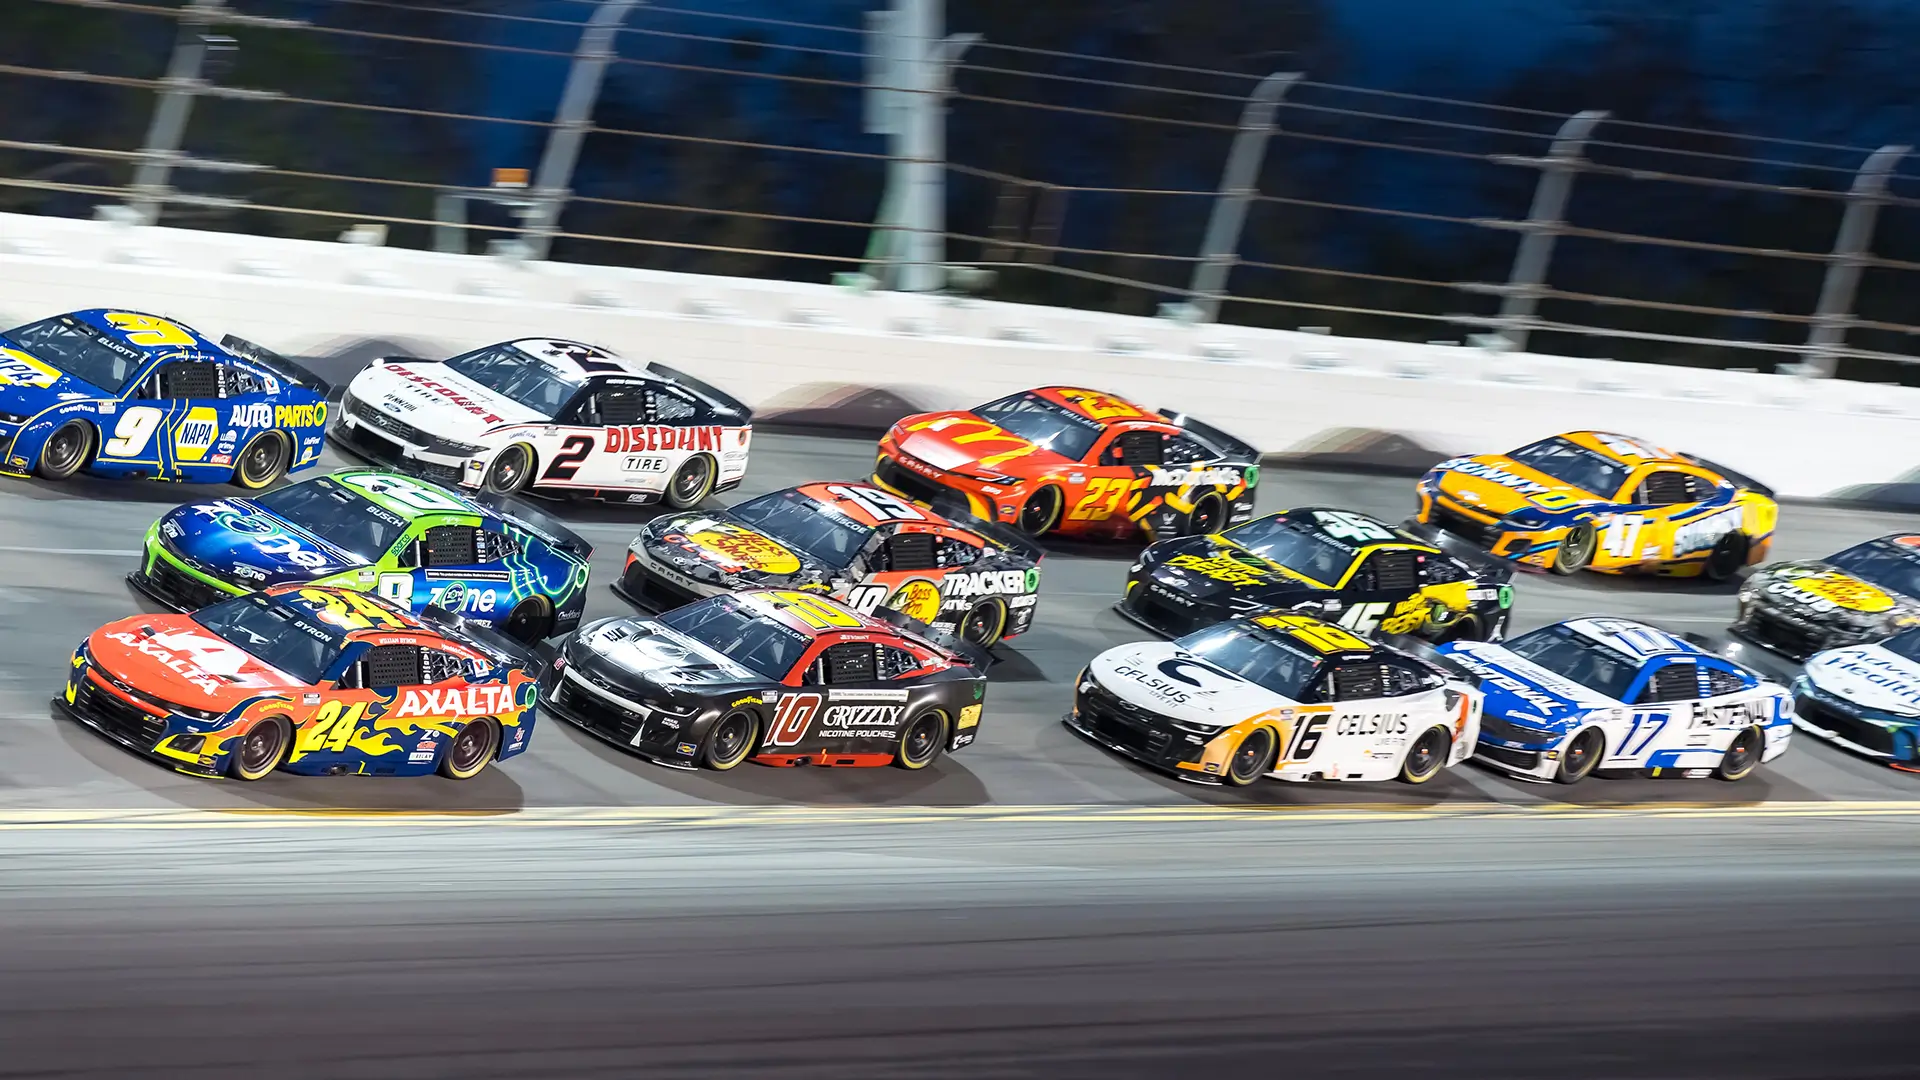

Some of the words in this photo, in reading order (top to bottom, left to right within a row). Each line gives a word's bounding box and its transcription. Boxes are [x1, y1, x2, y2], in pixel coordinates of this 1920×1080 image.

[98, 337, 138, 358] ELLIOTT
[59, 404, 96, 414] GOODYEAR
[228, 404, 273, 428] AUTO
[275, 404, 314, 428] PARTS
[105, 408, 162, 457] 9
[180, 422, 213, 445] NAPA
[604, 426, 722, 453] DISCOUNT
[218, 442, 235, 451] prime
[540, 435, 595, 481] 2
[627, 458, 662, 470] TIRE
[827, 486, 926, 521] 19
[1068, 478, 1132, 521] 23
[366, 505, 404, 528] BUSCH
[391, 533, 412, 557] sparco
[1602, 514, 1644, 558] 47
[650, 562, 695, 587] CAMRY
[943, 570, 1025, 596] TRACKER
[909, 585, 933, 600] Bass
[1767, 582, 1840, 613] CLUB
[299, 589, 407, 630] 24
[751, 591, 864, 630] 10
[1337, 602, 1390, 637] 45
[294, 620, 332, 643] BYRON
[774, 624, 807, 643] DILLON
[1250, 615, 1374, 655] 16
[105, 632, 219, 696] AXALTA
[1114, 666, 1191, 703] CELSIUS
[259, 702, 294, 712] GOODYEAR
[396, 685, 515, 717] AXALTA
[731, 696, 763, 708] GOODYEAR
[300, 700, 368, 753] 24
[762, 693, 822, 747] 10
[823, 705, 905, 729] GRIZZLY
[1336, 714, 1408, 735] CELSIUS
[819, 730, 853, 738] NICOTINE
[856, 730, 897, 738] POUCHES
[1283, 714, 1331, 760] 16
[1614, 713, 1670, 756] 17
